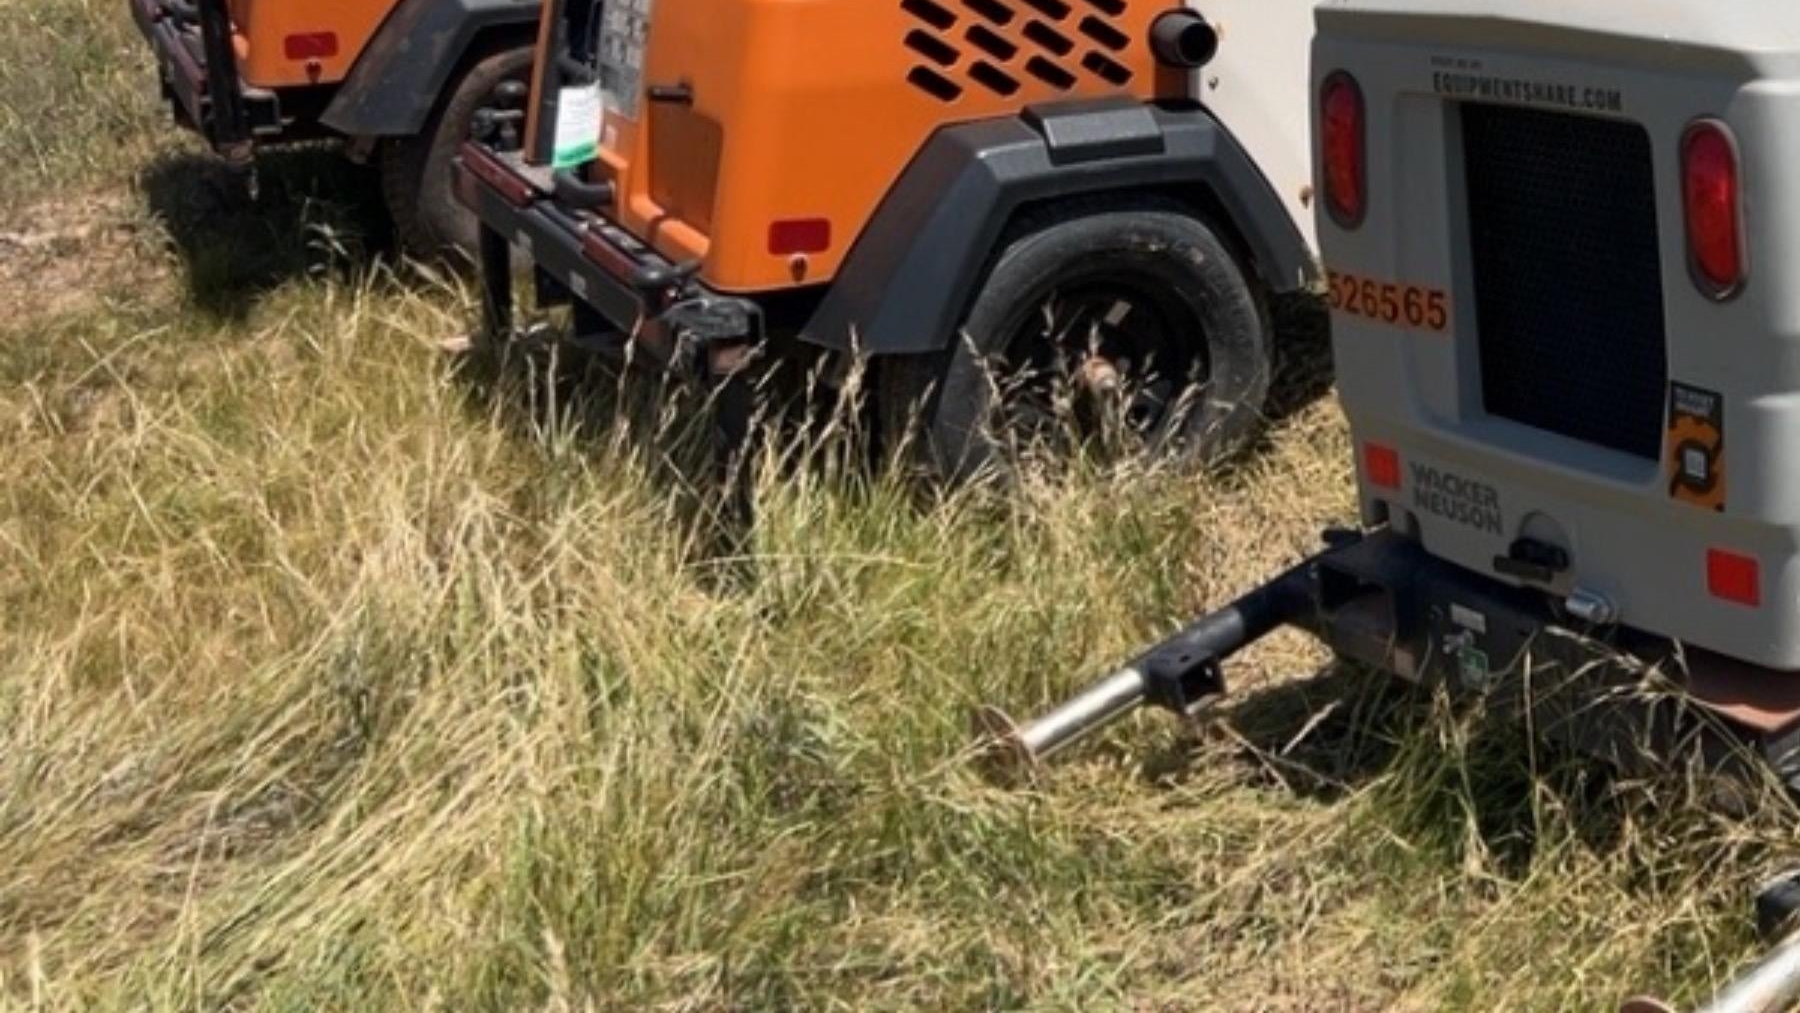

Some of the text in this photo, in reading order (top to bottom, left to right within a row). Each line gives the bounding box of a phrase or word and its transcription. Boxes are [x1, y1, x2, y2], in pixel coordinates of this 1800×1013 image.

[1325, 270, 1447, 331] 526565
[1408, 460, 1499, 511] WACKER
[1412, 486, 1504, 538] NEUSON
